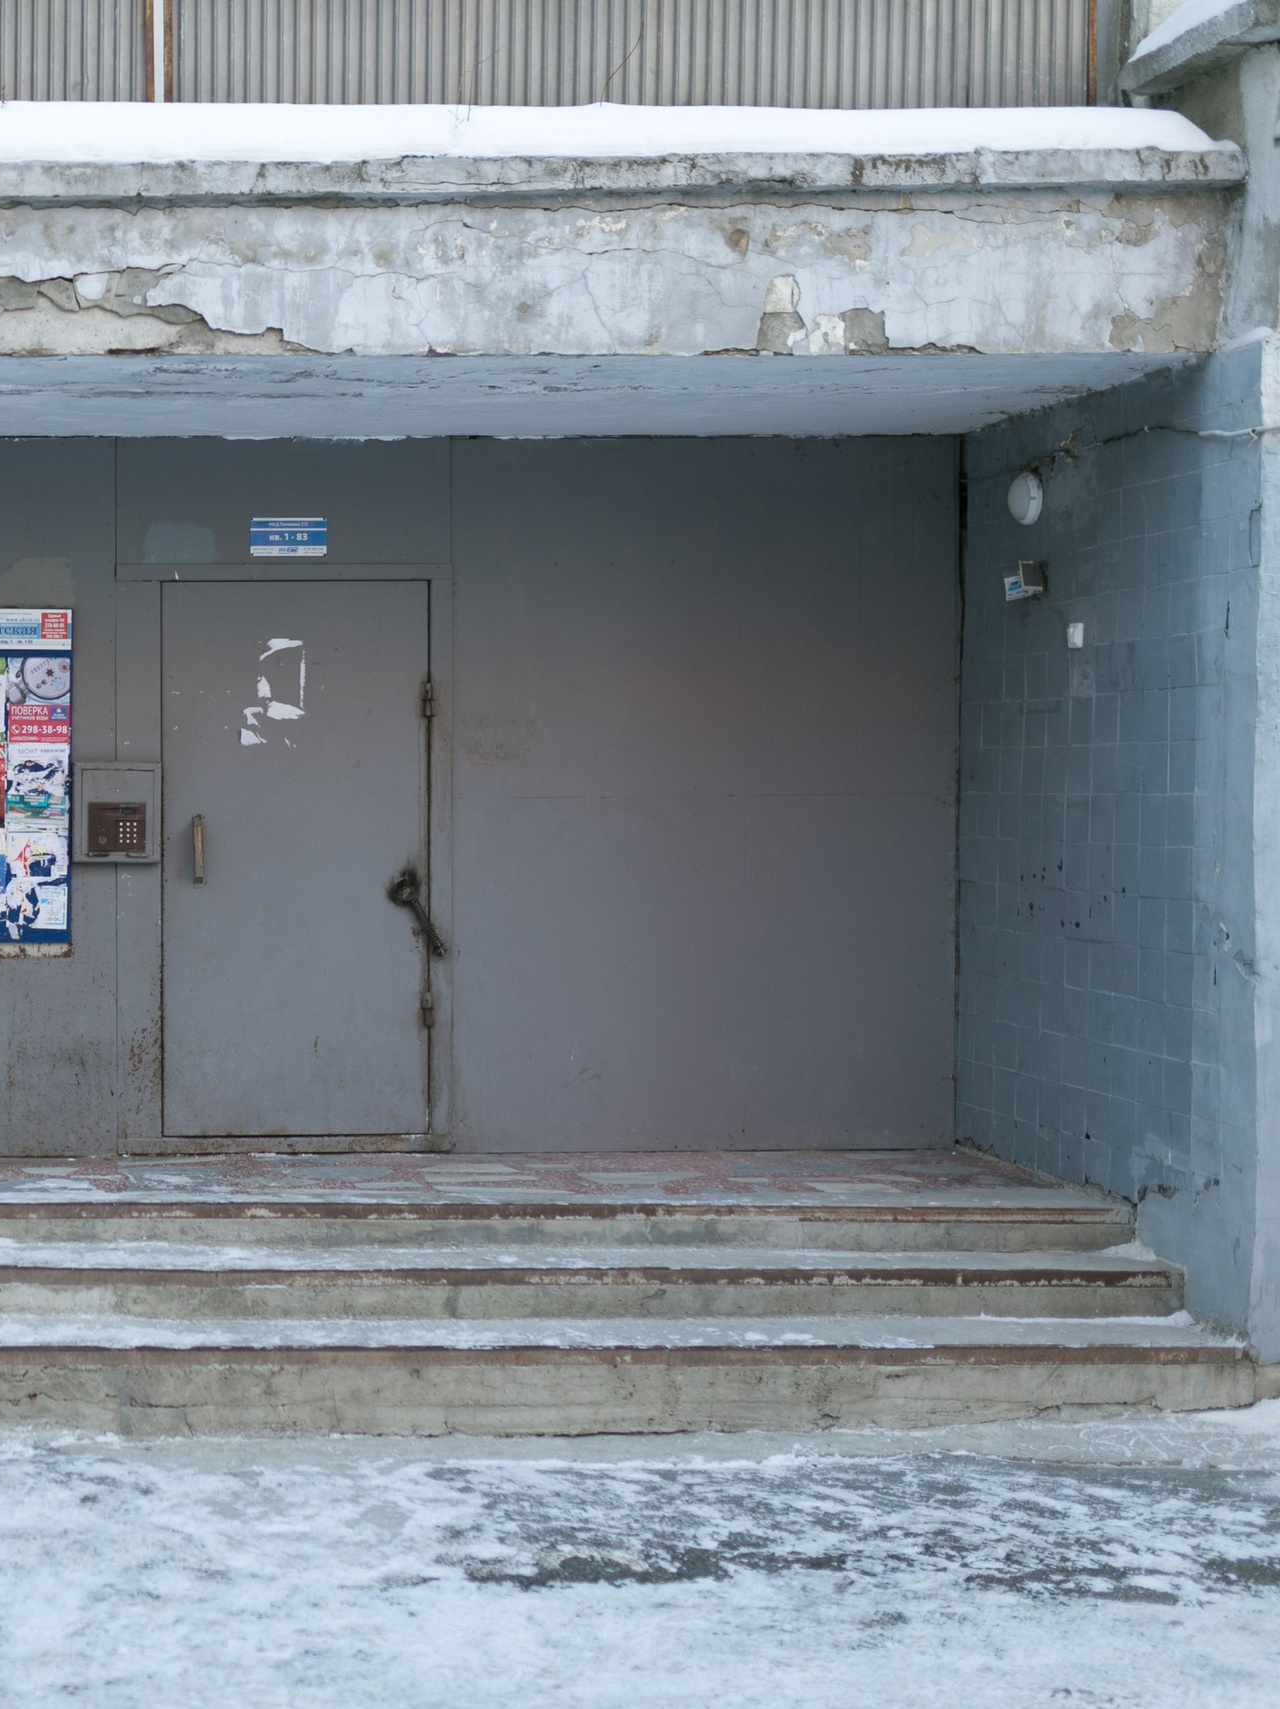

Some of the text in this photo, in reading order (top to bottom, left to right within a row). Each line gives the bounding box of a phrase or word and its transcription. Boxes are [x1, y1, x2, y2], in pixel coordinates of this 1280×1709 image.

[283, 533, 289, 541] 1
[296, 533, 308, 541] 83
[11, 706, 48, 716] ПОВЕРКА
[21, 725, 68, 734] 298-38-98
